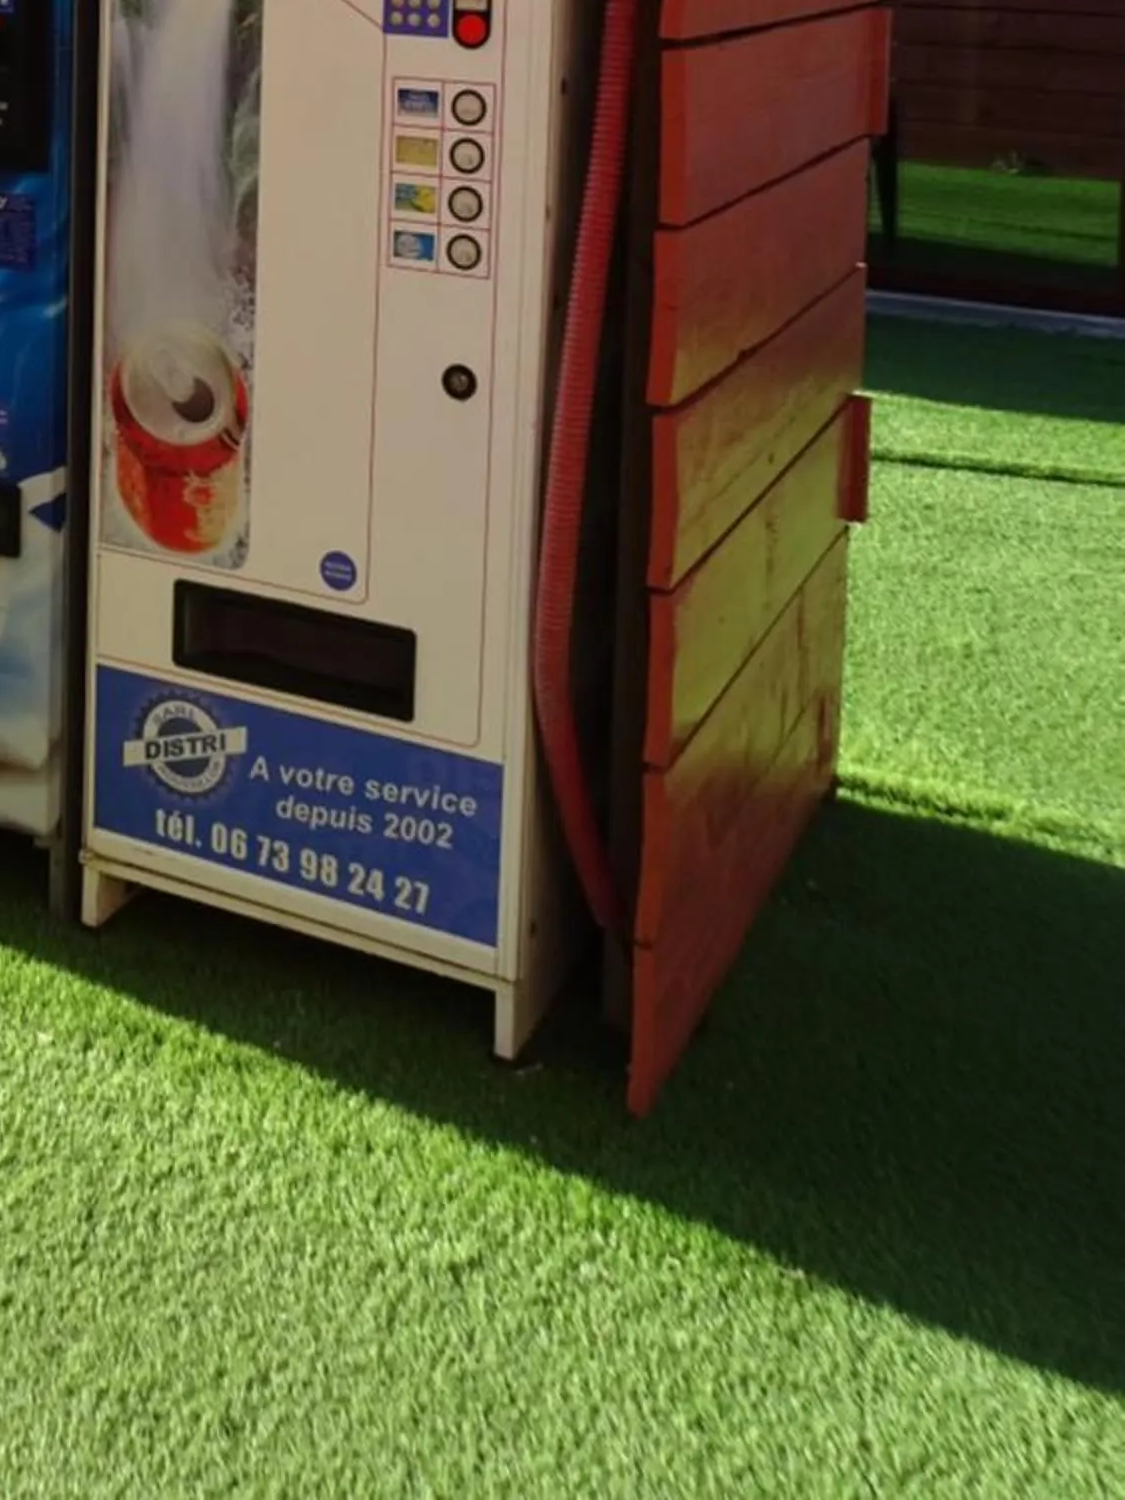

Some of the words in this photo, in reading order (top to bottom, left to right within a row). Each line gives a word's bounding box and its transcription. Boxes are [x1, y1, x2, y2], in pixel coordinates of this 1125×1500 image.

[143, 733, 226, 760] DISTRI
[248, 756, 270, 782] A
[279, 762, 356, 796] votre
[364, 778, 478, 818] service
[275, 798, 373, 834] depuis
[383, 812, 455, 850] 2002
[154, 807, 203, 848] tél.
[210, 821, 248, 861] 06
[256, 834, 291, 874] 73
[299, 847, 339, 888] 98
[347, 861, 385, 902] 24
[393, 875, 431, 915] 27
